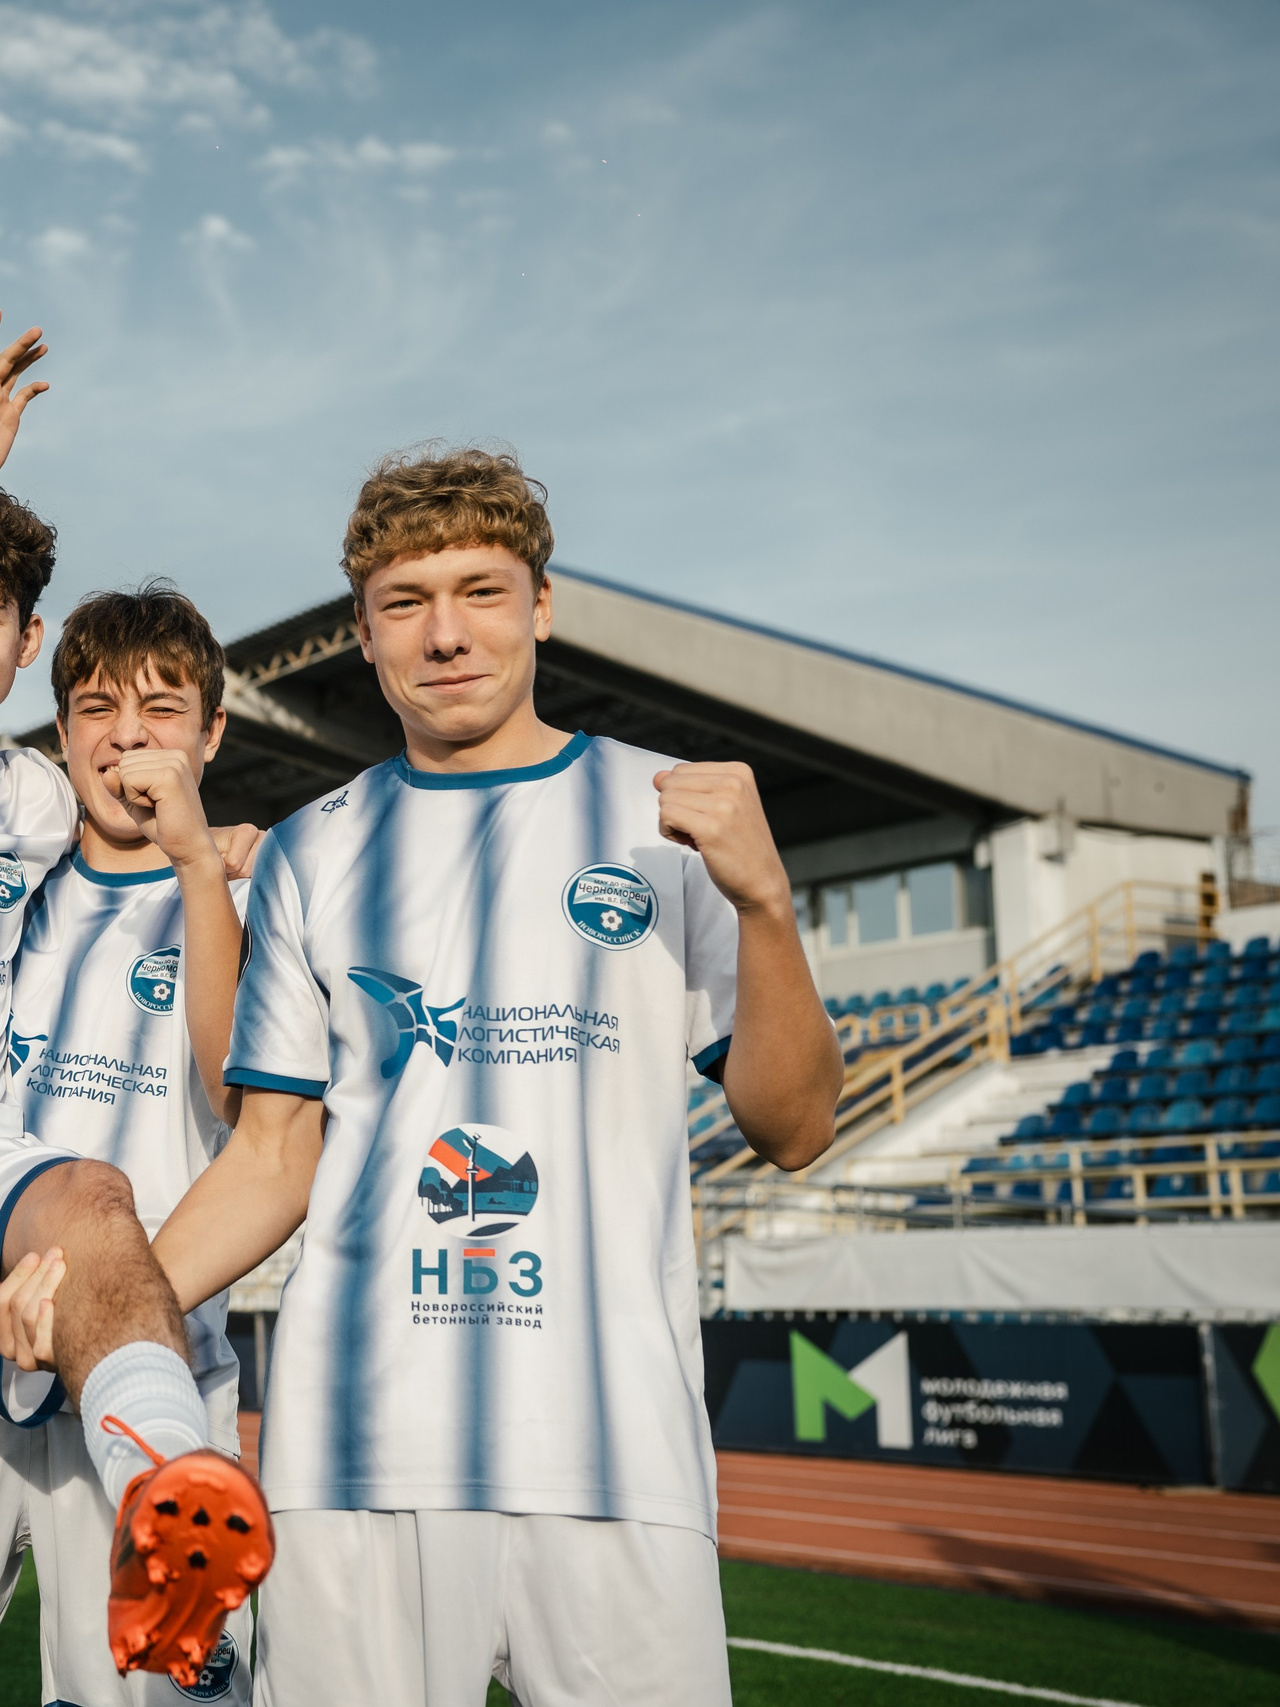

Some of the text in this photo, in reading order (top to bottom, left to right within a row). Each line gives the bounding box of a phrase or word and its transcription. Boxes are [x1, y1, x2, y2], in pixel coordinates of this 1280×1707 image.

[578, 882, 647, 904] Черноморец
[141, 963, 178, 973] Черномо
[134, 991, 174, 1011] НОВОРОССИ
[461, 1003, 619, 1031] НАЦИОНАЛЬНАЯ
[458, 1025, 620, 1054] ЛОГИСТИЧЕСКАЯ
[39, 1047, 167, 1080] НАЦИОНАЛЬНАЯ
[458, 1047, 578, 1065] КОМПАНИЯ
[26, 1077, 116, 1105] КОМПАНИЯ
[31, 1064, 168, 1097] ЛОГИСТИЧЕСКАЯ
[412, 1248, 544, 1298] НБЗ
[411, 1301, 544, 1316] Новороссийский
[412, 1313, 543, 1330] бетонный завод
[920, 1376, 1069, 1401] молодежная
[920, 1399, 1064, 1428] футбольная
[922, 1427, 978, 1449] лига
